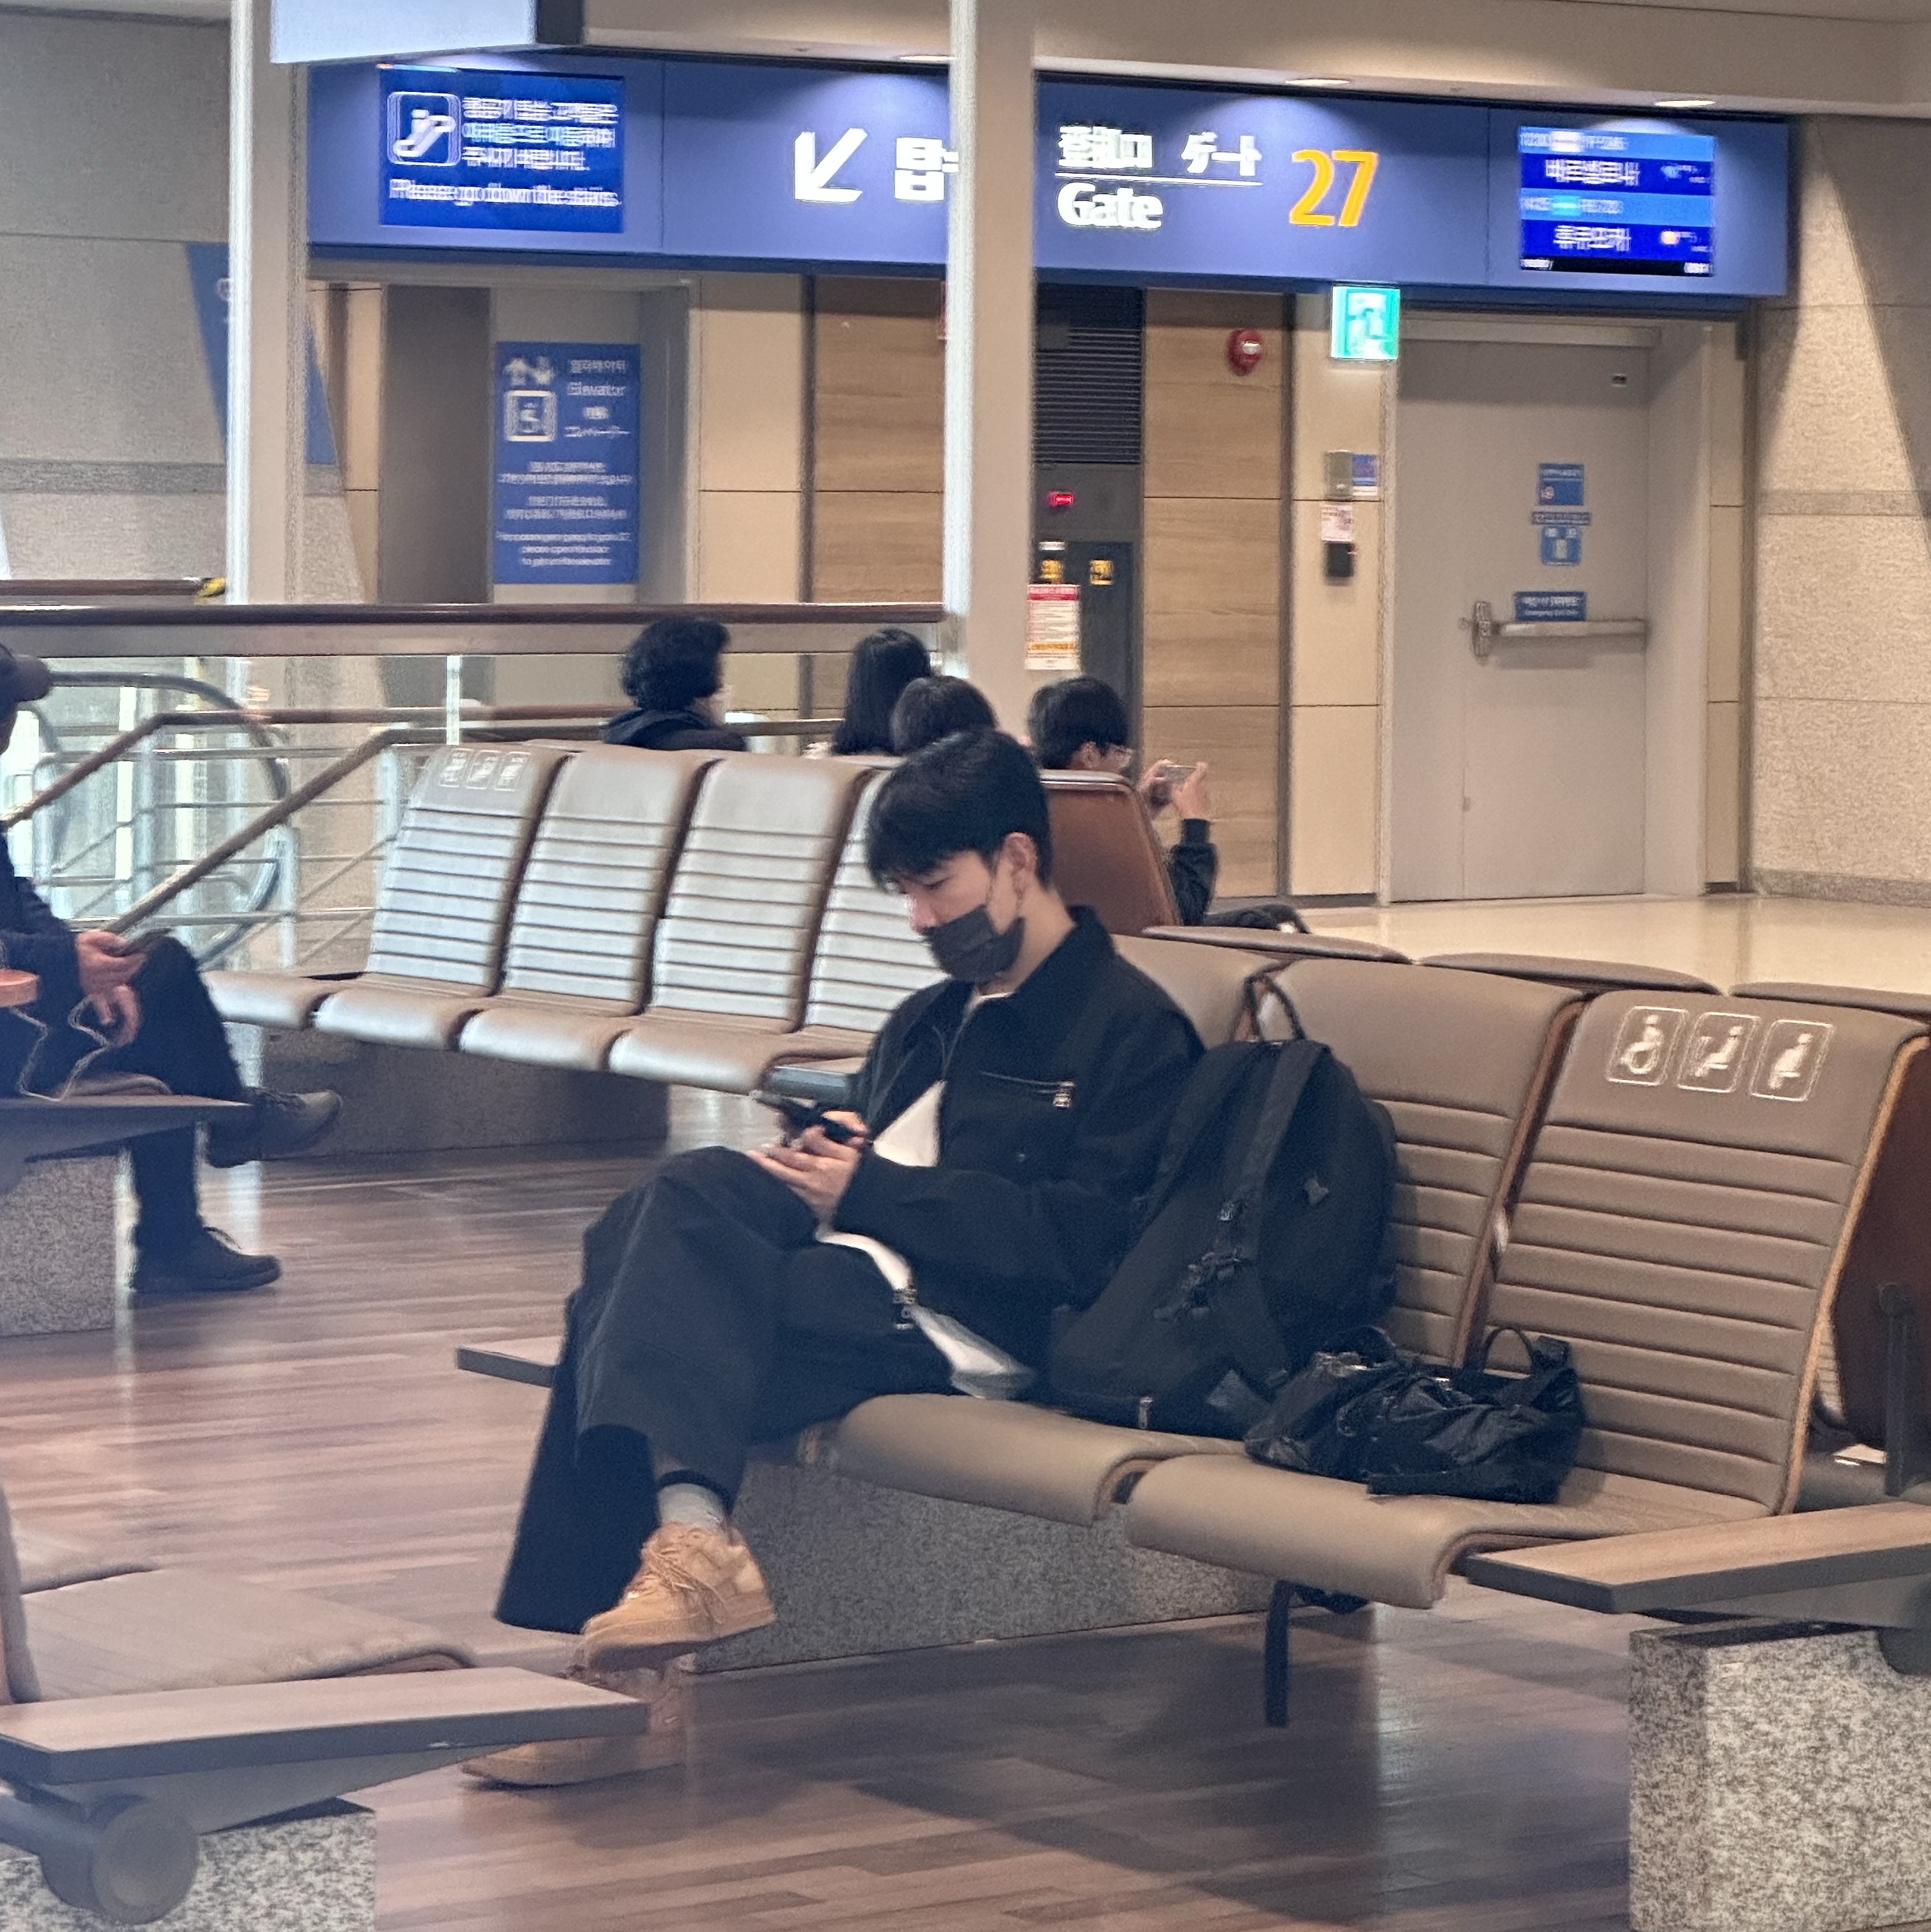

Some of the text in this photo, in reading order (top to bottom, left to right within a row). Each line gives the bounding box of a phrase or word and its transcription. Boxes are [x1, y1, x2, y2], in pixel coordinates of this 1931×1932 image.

[1180, 131, 1263, 177] ゲート
[1057, 182, 1163, 229] Gate
[1289, 149, 1381, 227] 27
